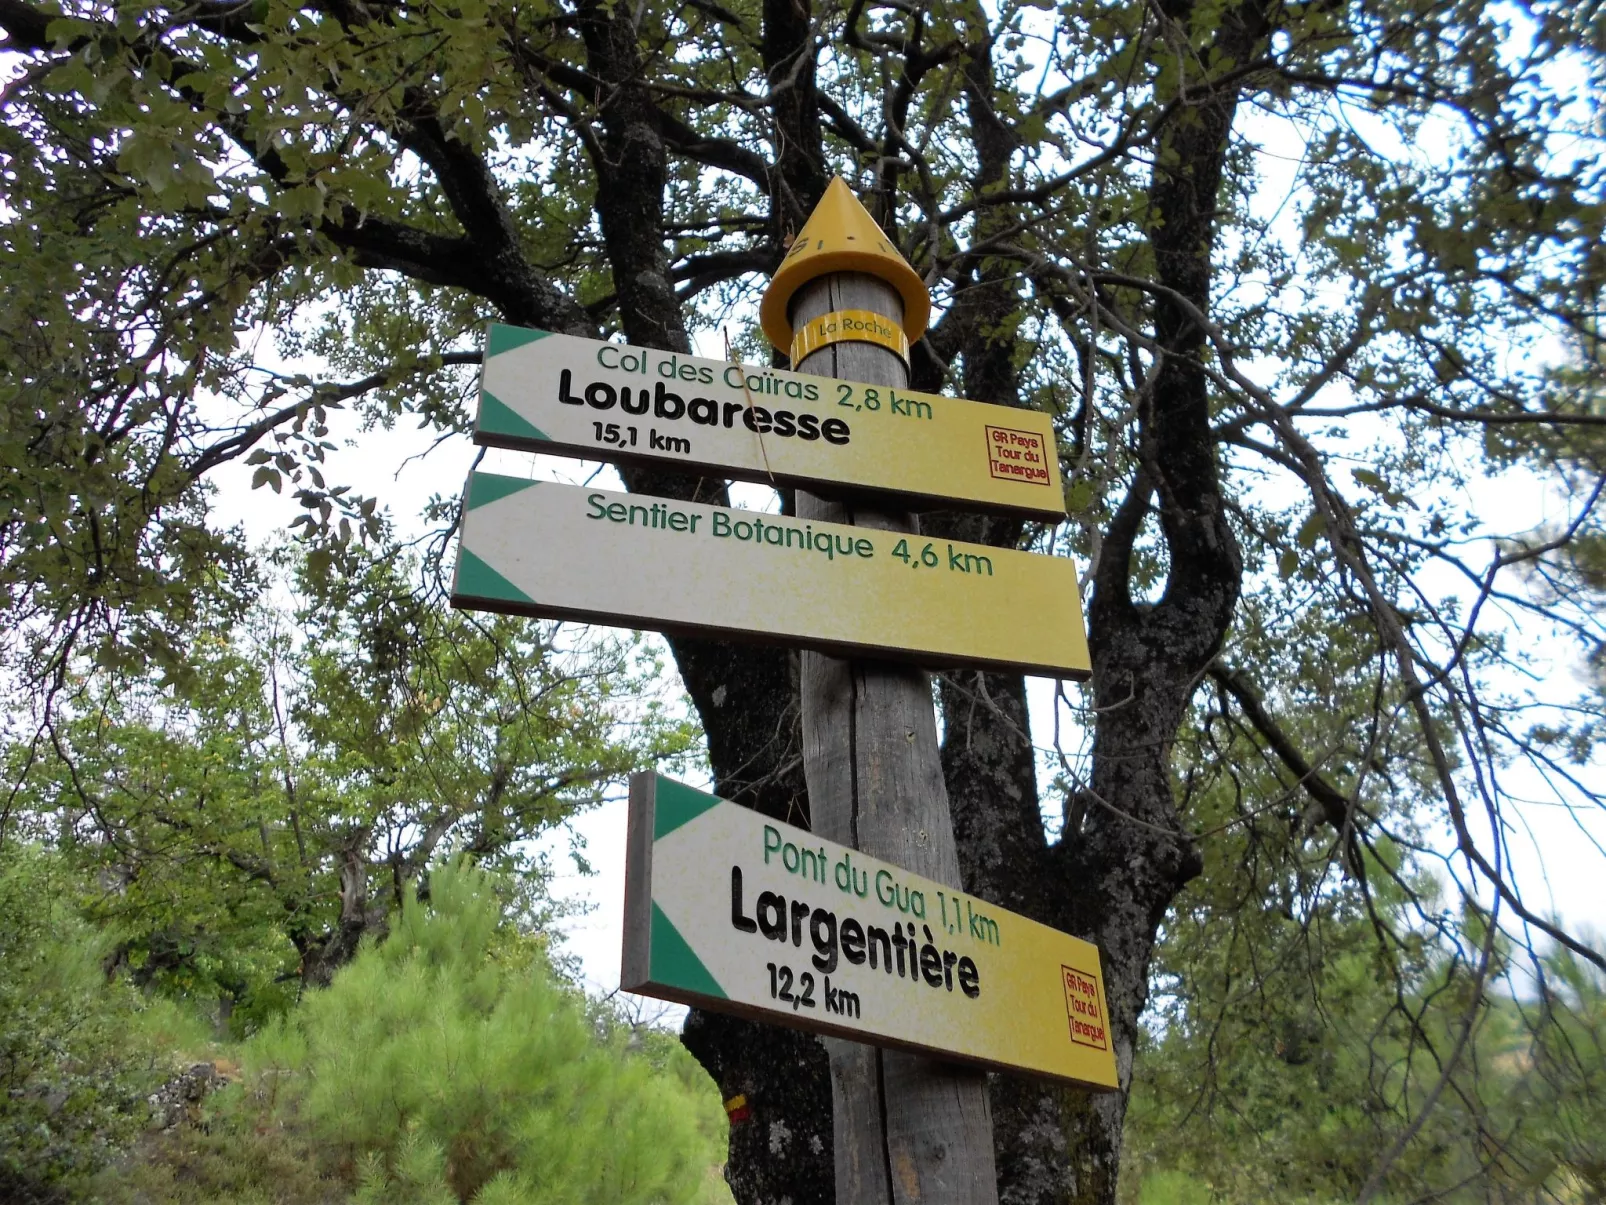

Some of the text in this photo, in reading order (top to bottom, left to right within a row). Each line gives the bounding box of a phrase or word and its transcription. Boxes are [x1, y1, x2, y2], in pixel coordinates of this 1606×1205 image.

[820, 318, 892, 338] La Roche
[597, 346, 933, 420] Col des Caïras 2,8 km
[558, 368, 851, 445] Loubaresse
[592, 421, 691, 454] 15,1 km
[992, 430, 1038, 449] GR Pays
[995, 445, 1040, 463] Tour du
[991, 460, 1047, 479] Tanargue
[586, 493, 993, 576] Sentier Botanique 4,6 km
[764, 824, 1000, 946] Pont du Gua 1,1 km
[731, 865, 981, 999] Largentière
[766, 962, 861, 1019] 12,2 km
[1066, 972, 1095, 998] GR Pays
[1070, 994, 1098, 1019] Tour du
